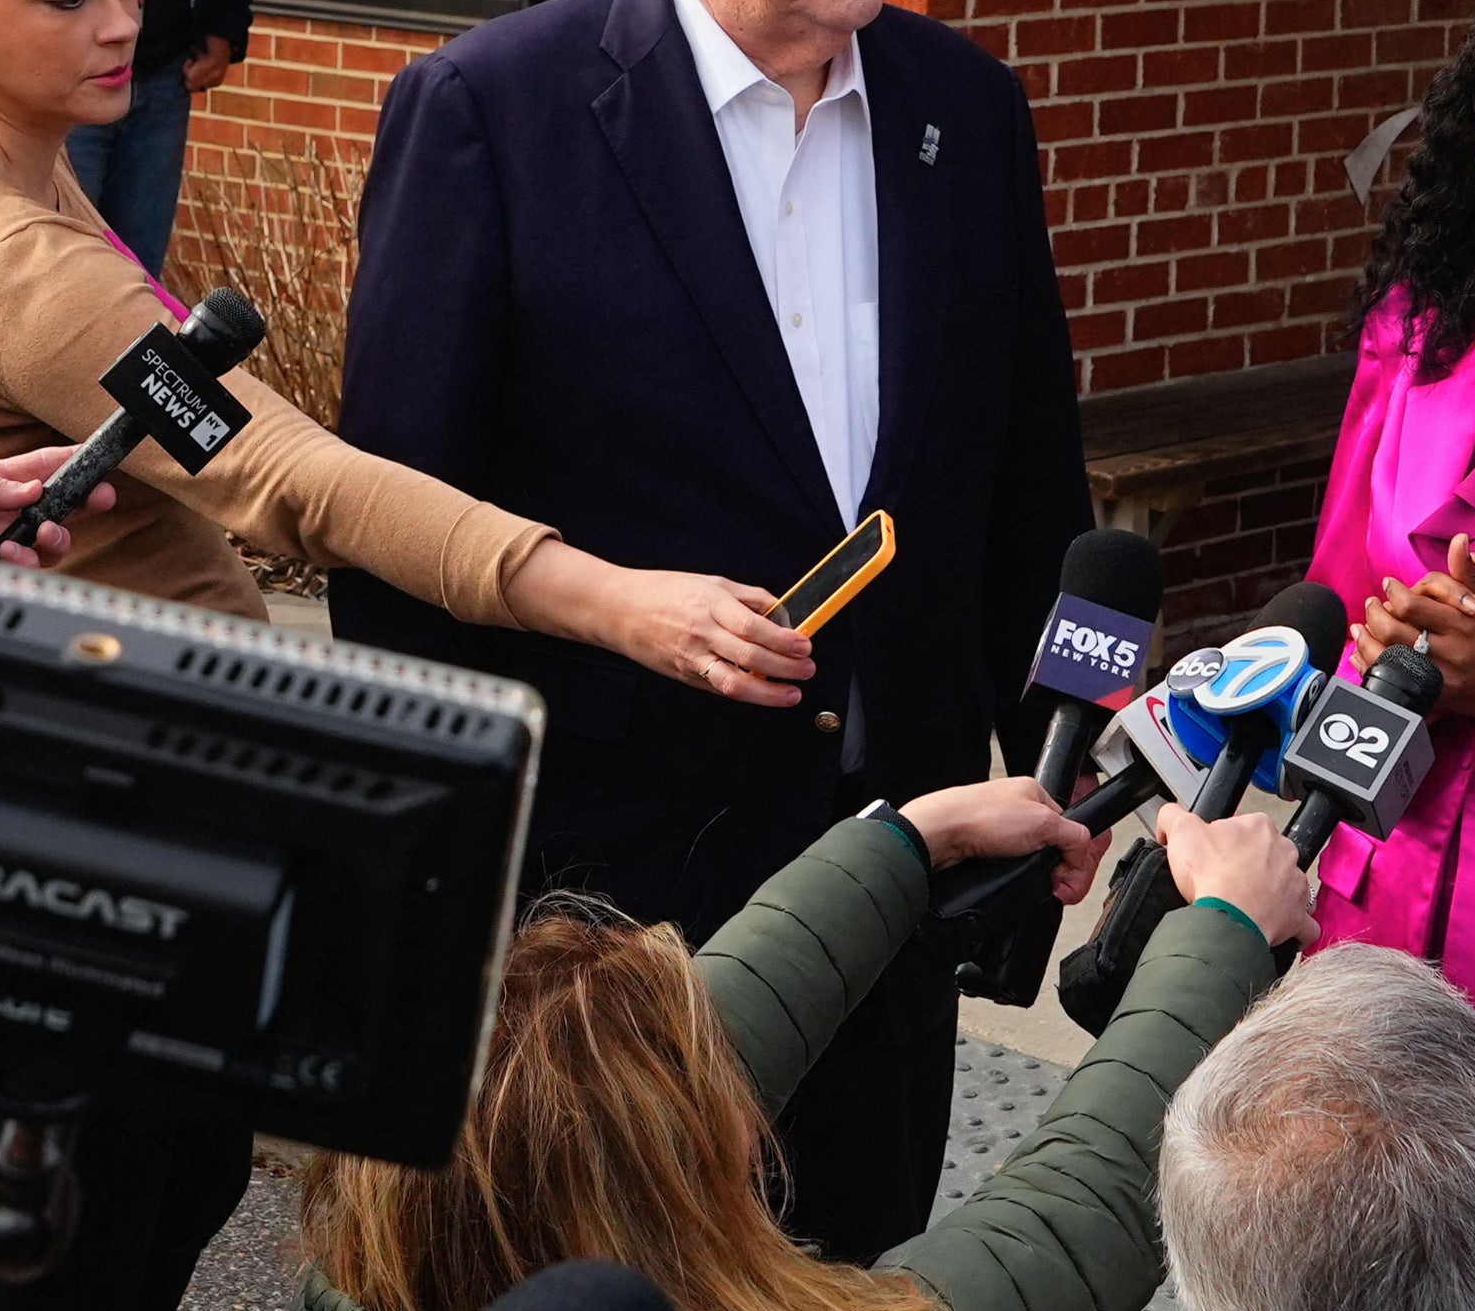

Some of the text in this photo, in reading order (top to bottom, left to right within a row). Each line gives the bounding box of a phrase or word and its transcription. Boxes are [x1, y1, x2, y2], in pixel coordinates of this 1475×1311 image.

[141, 348, 208, 415] SPECTRUM
[140, 373, 196, 428] NEWS
[206, 416, 221, 430] NY
[206, 434, 218, 447] 1
[1051, 645, 1131, 679] NEW YORK
[1170, 657, 1221, 677] abc
[1346, 725, 1390, 769] 2
